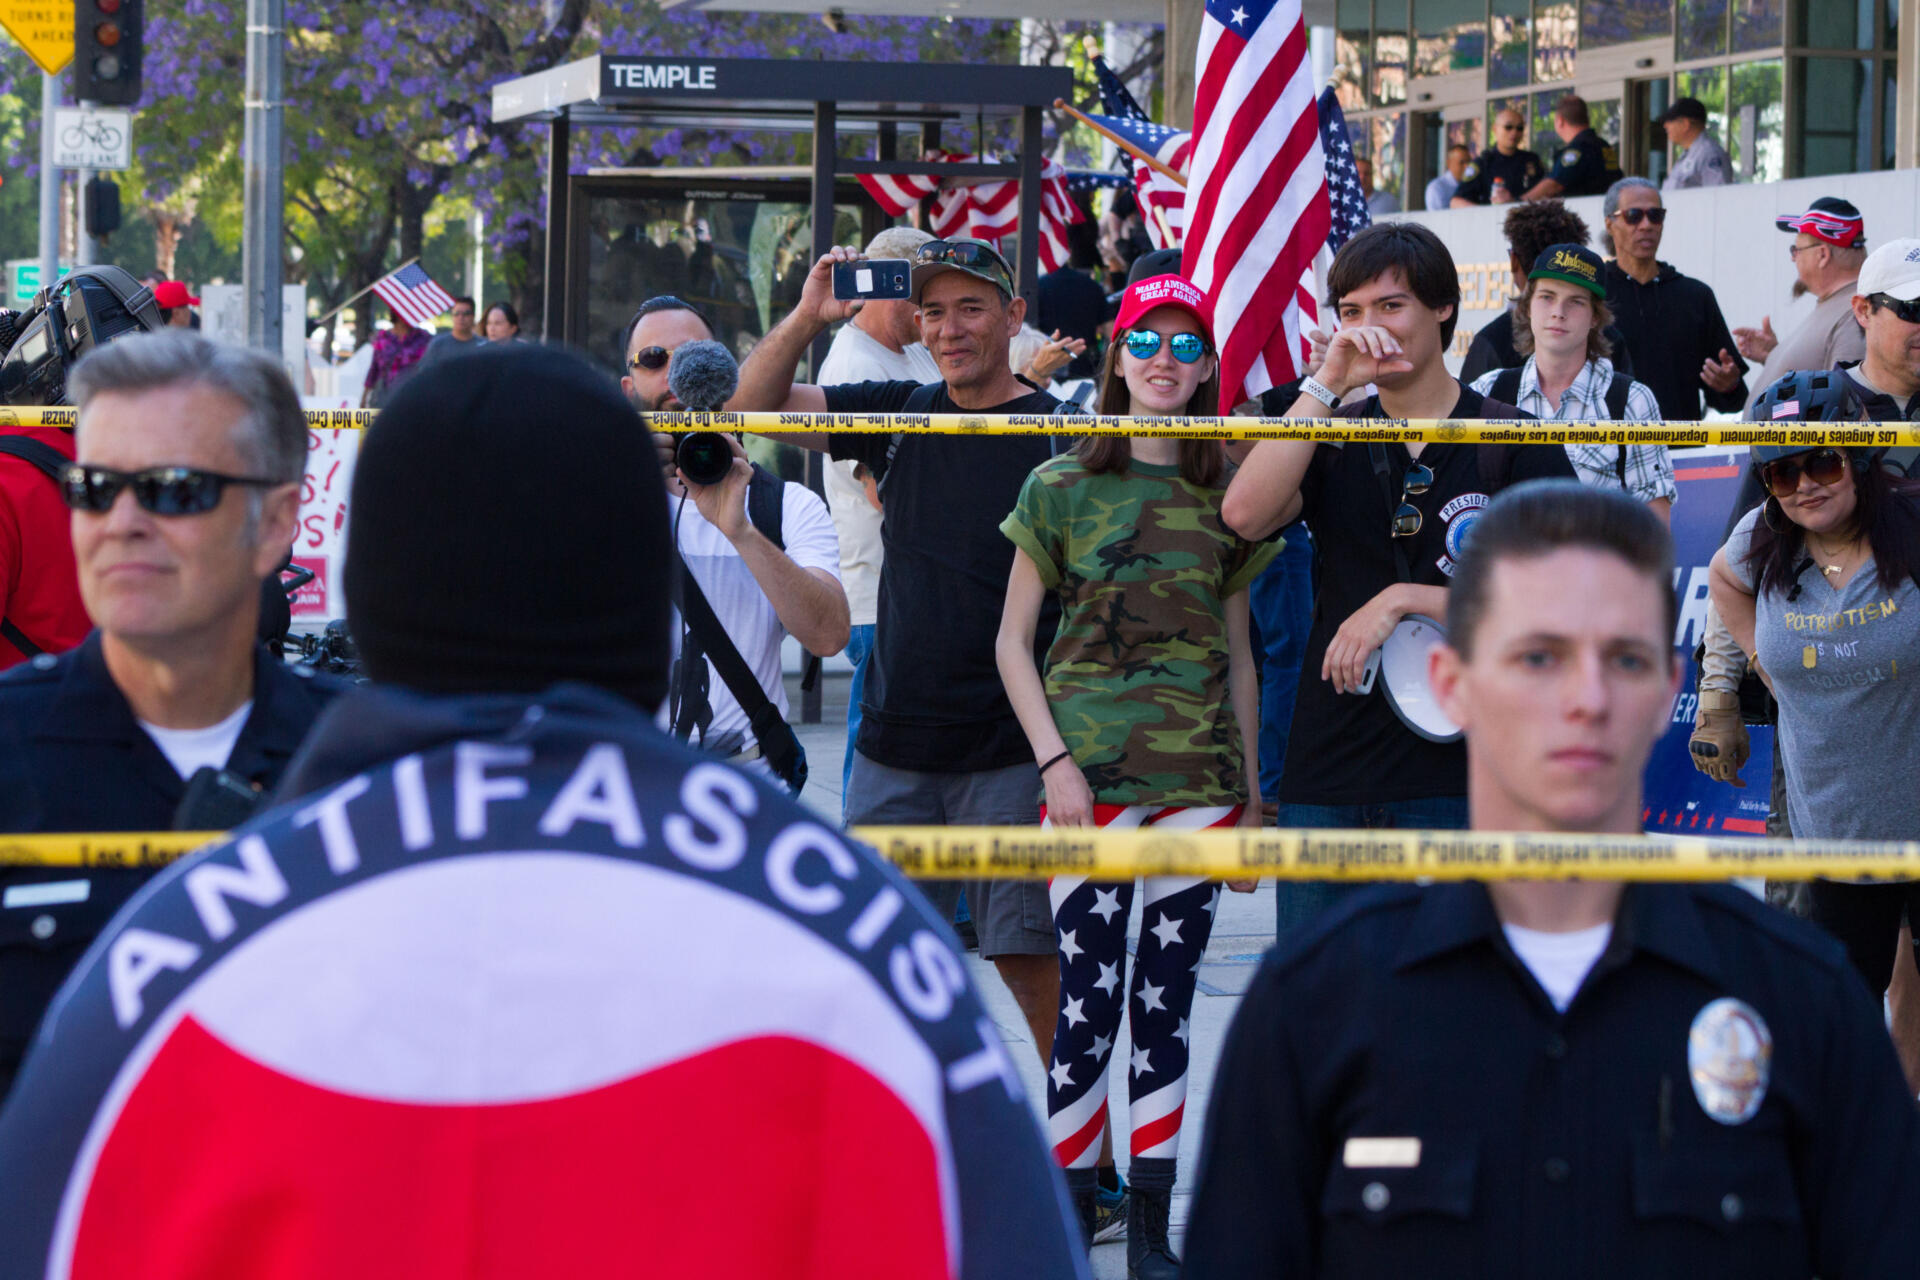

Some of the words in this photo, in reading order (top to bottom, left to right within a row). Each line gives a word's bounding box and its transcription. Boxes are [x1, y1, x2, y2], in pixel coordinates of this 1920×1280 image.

[609, 64, 717, 89] TEMPLE
[1135, 281, 1162, 296] MAKE
[1163, 279, 1202, 303] AMERICA
[1140, 289, 1170, 303] GREAT
[1172, 289, 1197, 307] AGAIN
[40, 410, 78, 427] Cruzar
[304, 411, 328, 428] Cro
[332, 411, 352, 428] Not
[696, 412, 710, 427] De
[779, 413, 812, 428] Cross
[895, 414, 930, 428] Police
[1244, 430, 1311, 441] Department
[1314, 431, 1351, 441] Police
[1353, 430, 1400, 441] Angeles
[1403, 431, 1423, 441] Los
[1480, 429, 1526, 442] Angeles
[1528, 430, 1548, 442] Los
[1550, 430, 1566, 442] De
[1568, 430, 1607, 442] Policia
[1609, 430, 1625, 443] De
[1627, 429, 1709, 443] Departamento
[1720, 429, 1787, 444] Department
[1789, 430, 1825, 444] Police
[1828, 428, 1875, 445] Angeles
[1878, 430, 1898, 445] Los
[1442, 494, 1489, 518] PRESIDE
[1833, 640, 1860, 658] NOT
[933, 836, 978, 869] Los
[988, 835, 1095, 871] Angeles
[1238, 835, 1283, 868] Los
[1296, 835, 1404, 873] Angeles
[1417, 835, 1500, 864] Police
[107, 740, 1027, 1103] ANTIFASCIST
